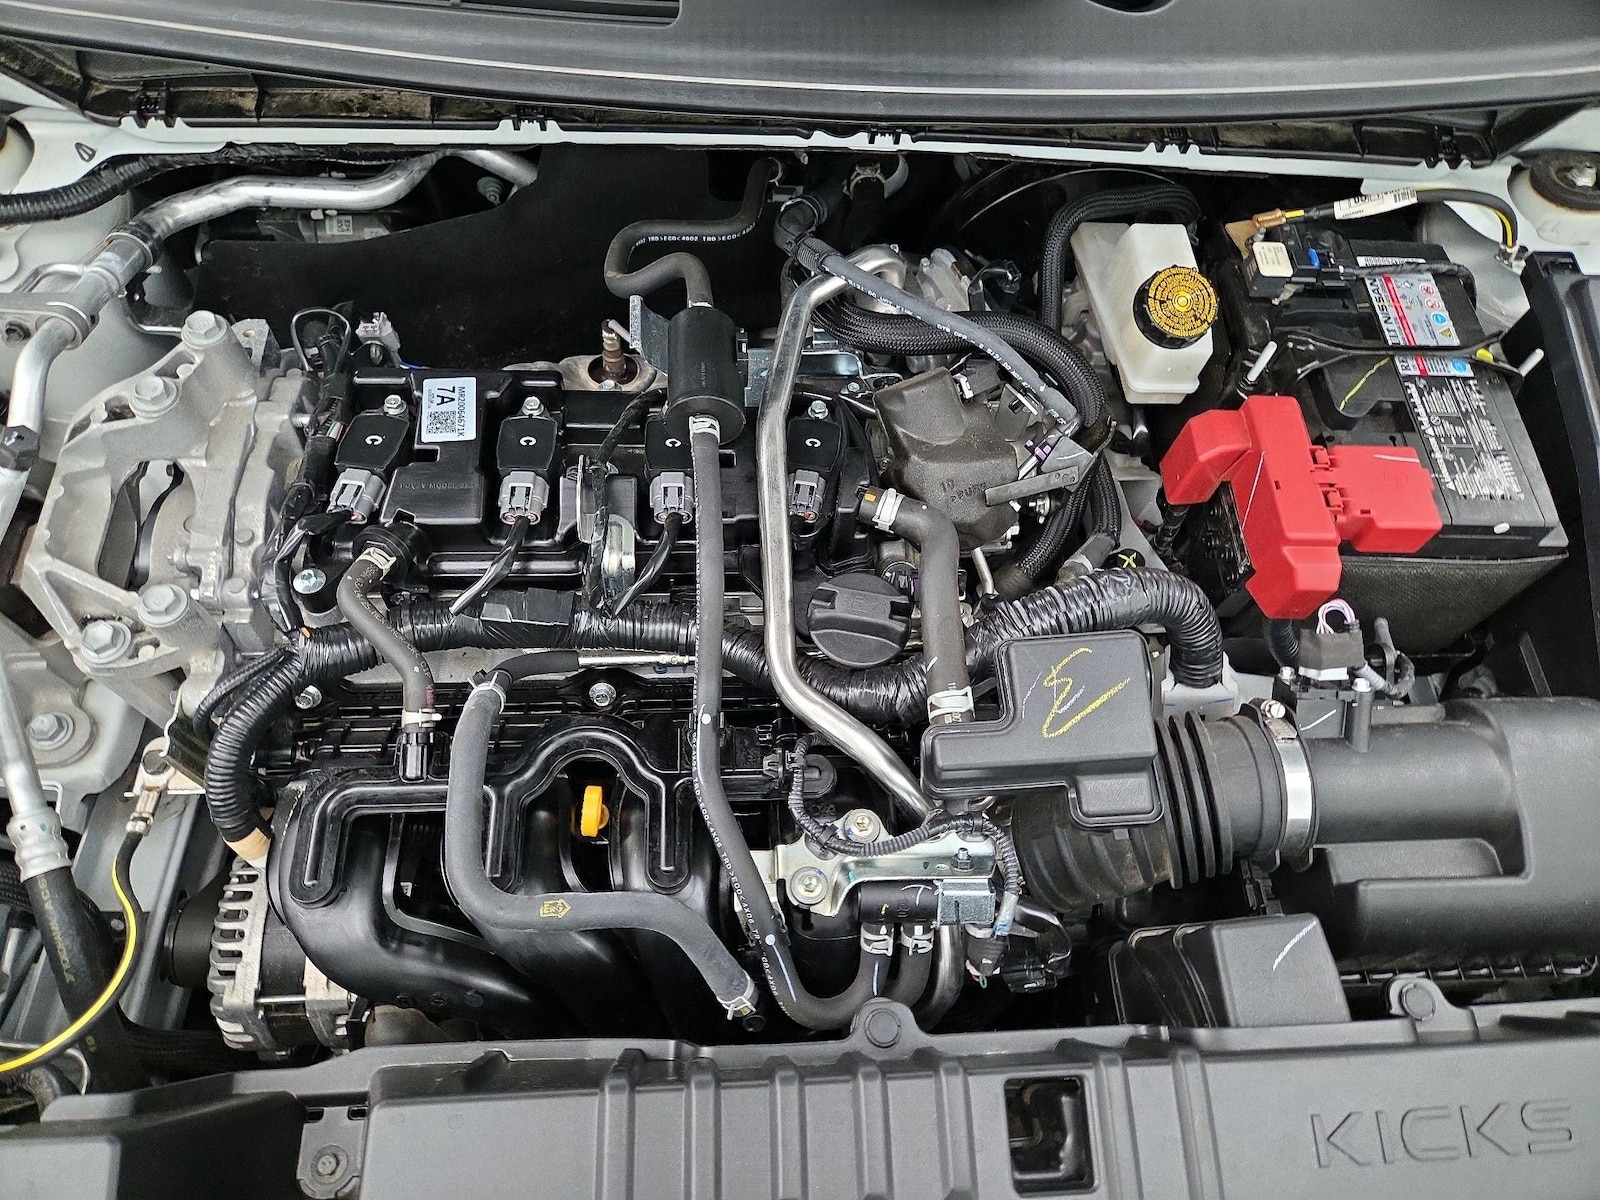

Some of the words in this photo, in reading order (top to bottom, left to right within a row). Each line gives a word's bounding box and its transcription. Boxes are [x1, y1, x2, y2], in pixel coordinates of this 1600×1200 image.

[1369, 278, 1393, 325] NISSAN
[436, 386, 456, 406] 7A
[365, 434, 383, 446] C
[519, 436, 537, 446] C
[664, 438, 682, 448] C
[805, 438, 822, 448] C
[1311, 1100, 1575, 1168] KICKS
